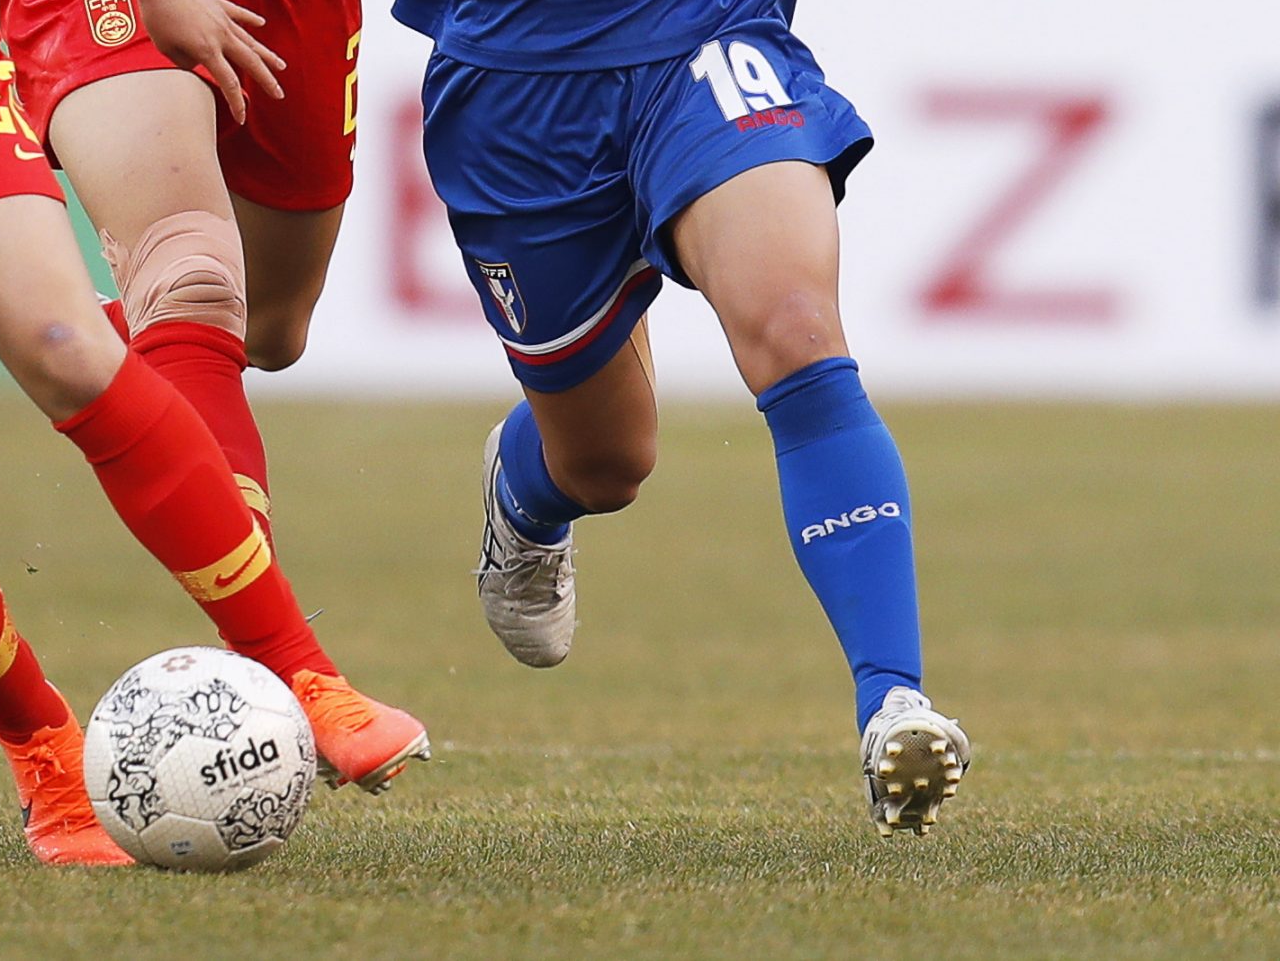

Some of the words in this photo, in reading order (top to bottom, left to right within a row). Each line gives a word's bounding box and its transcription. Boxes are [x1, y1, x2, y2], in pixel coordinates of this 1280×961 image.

[688, 39, 793, 122] 19
[736, 108, 804, 132] ANGO
[801, 501, 900, 545] ANGO
[200, 737, 280, 786] sfida
